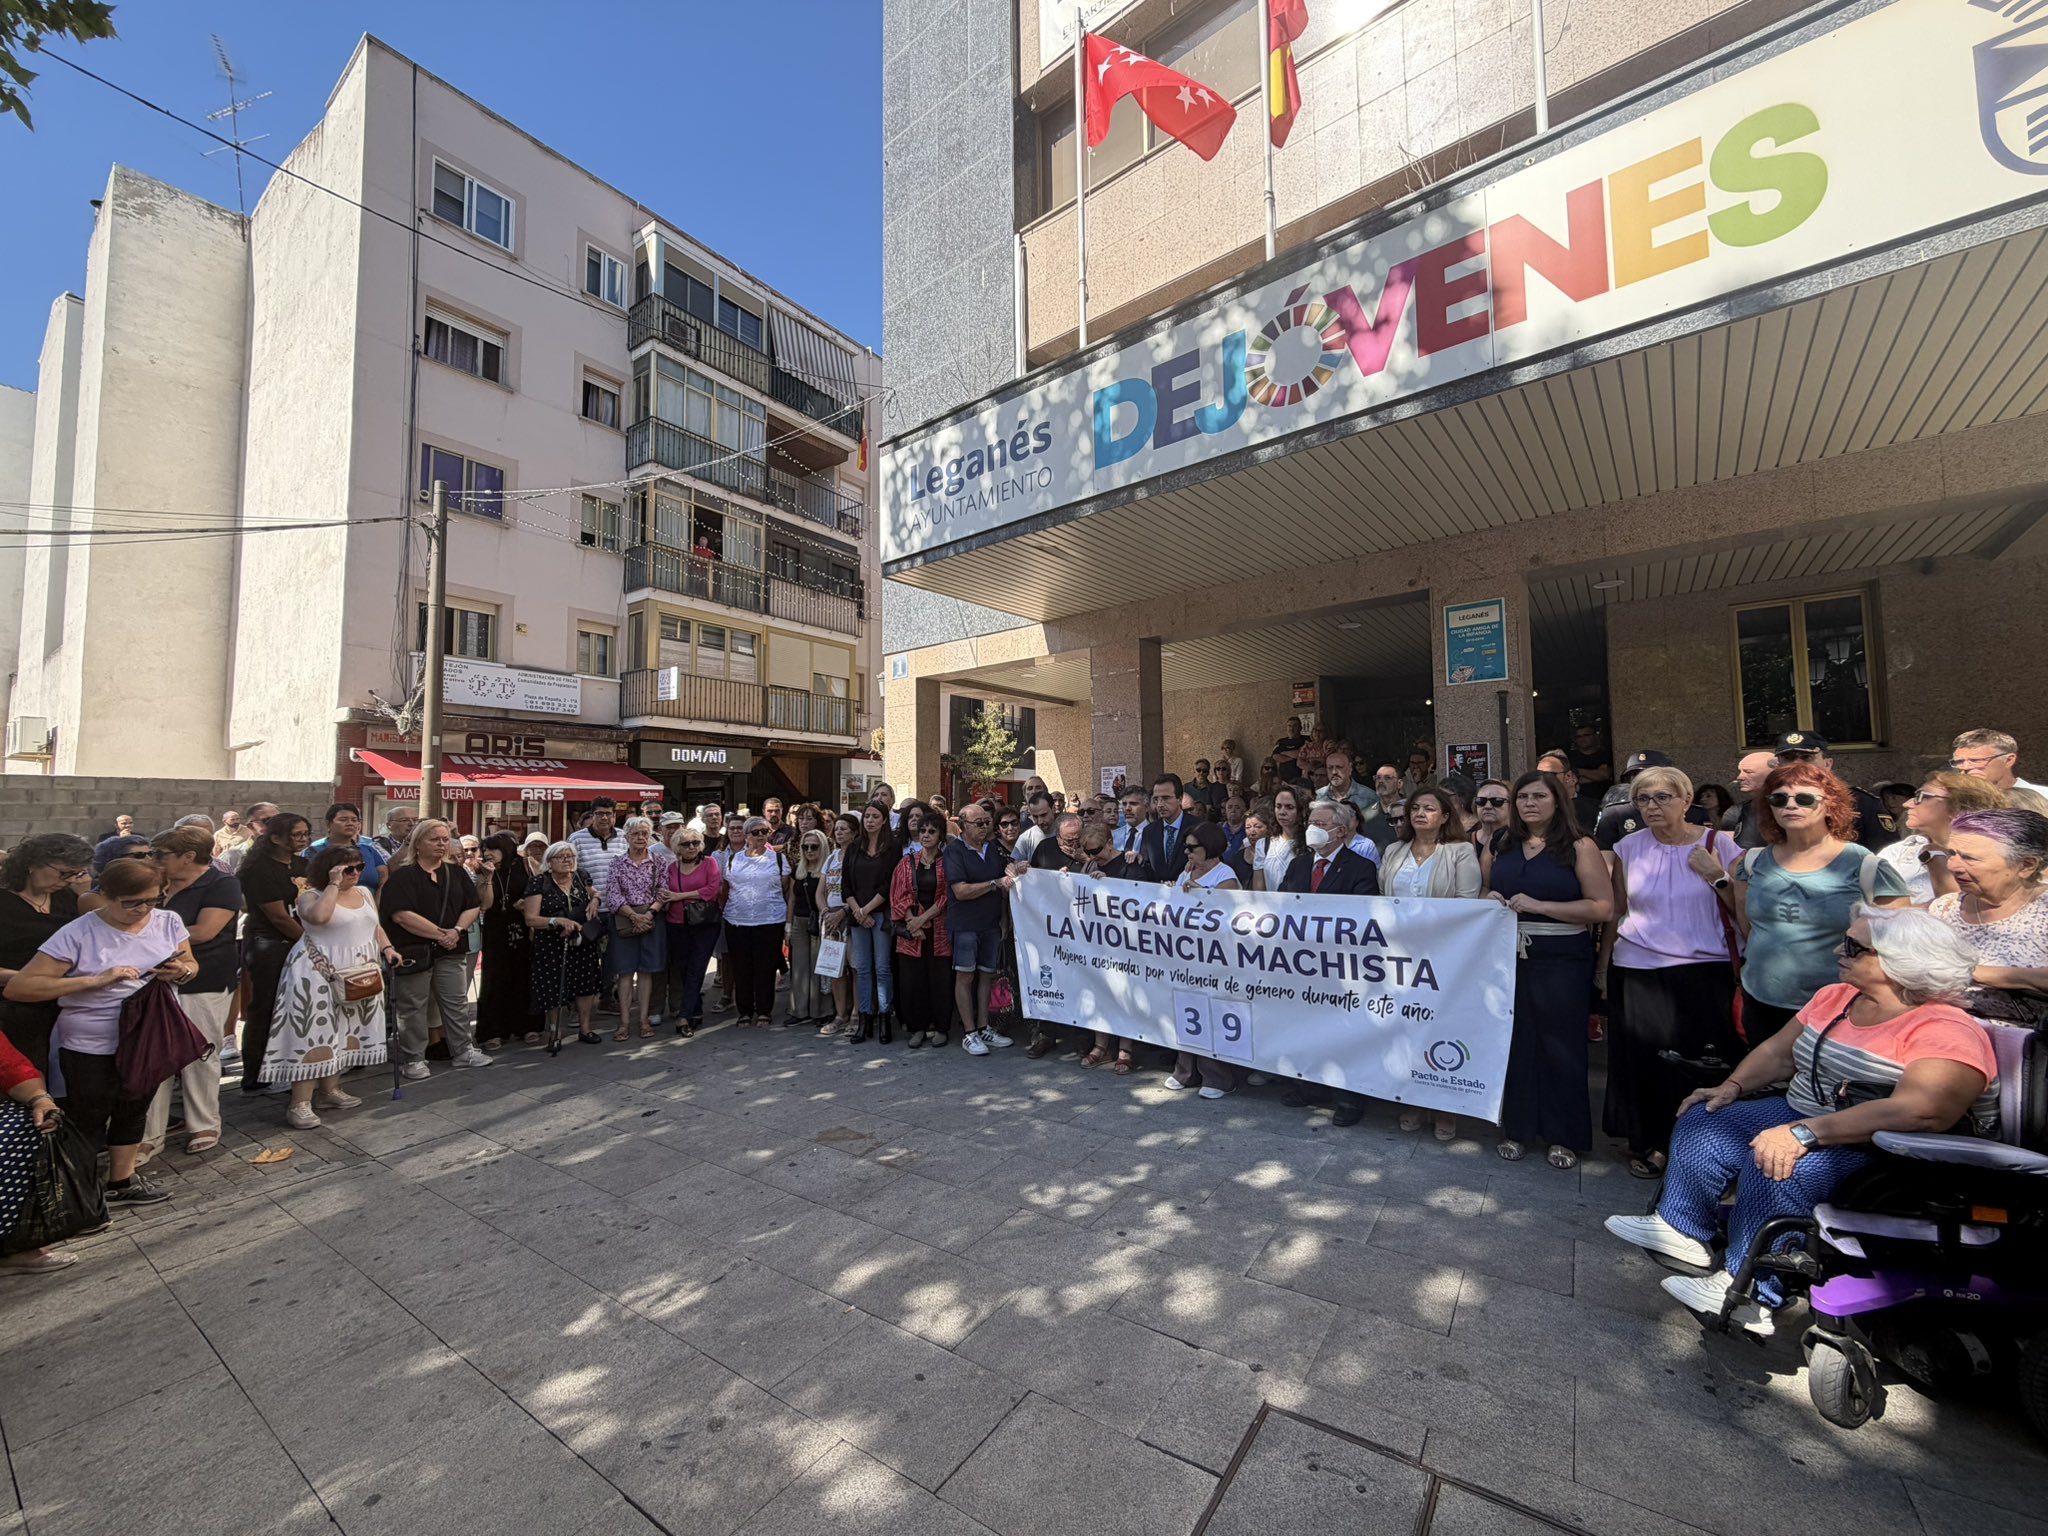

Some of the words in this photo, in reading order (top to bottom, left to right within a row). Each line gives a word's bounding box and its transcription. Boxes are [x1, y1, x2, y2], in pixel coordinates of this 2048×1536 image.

[911, 419, 1052, 501] Leganés
[910, 466, 1053, 533] AYUNTAMIENTO
[1458, 611, 1489, 621] LEGANÉS
[477, 680, 486, 691] P
[499, 682, 509, 694] T
[394, 787, 474, 800] MARUERÍA
[1073, 885, 1224, 933] #LEGANÉS
[1231, 911, 1388, 948] CONTRA
[1047, 915, 1075, 940] LA
[1080, 919, 1229, 967] VIOLENCIA
[1237, 942, 1440, 992] MACHISTA
[1053, 944, 1087, 967] Mujeres
[1091, 956, 1141, 976] asesinadas
[1145, 965, 1164, 983] por
[1169, 967, 1219, 991] violencia
[1224, 975, 1239, 994] de
[1245, 979, 1295, 1000] género
[1301, 985, 1360, 1013] durante
[1367, 994, 1394, 1019] este
[1027, 986, 1065, 1000] Leganés
[1411, 1069, 1439, 1082] Pacto
[1450, 1075, 1486, 1090] Estado
